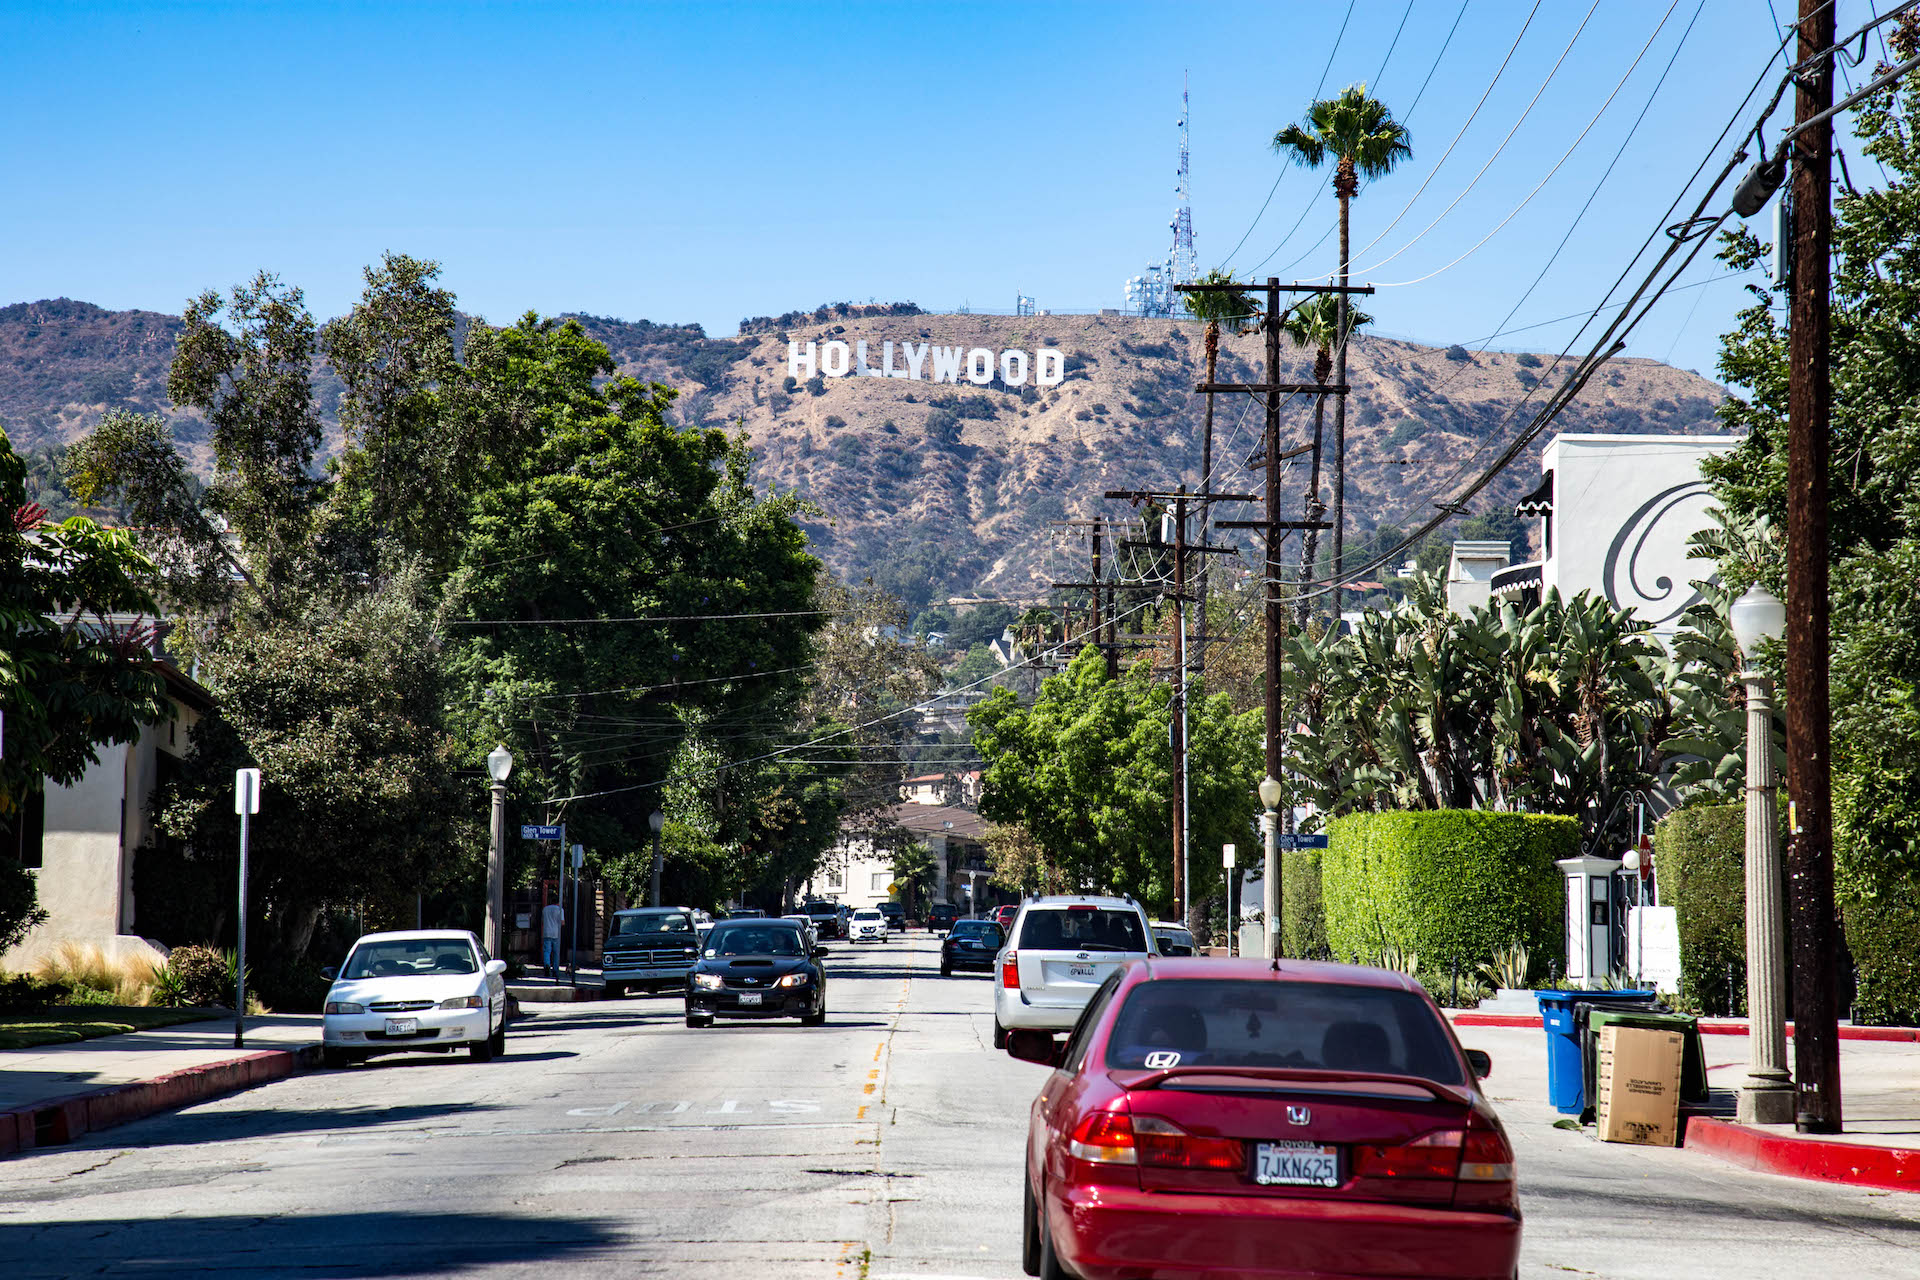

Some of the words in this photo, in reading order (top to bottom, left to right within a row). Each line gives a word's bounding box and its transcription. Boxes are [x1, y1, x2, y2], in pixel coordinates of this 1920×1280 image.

[788, 340, 1064, 386] HOLLYWOOD
[523, 826, 537, 834] Glen
[539, 826, 557, 834] Tower
[1280, 835, 1295, 843] Glen
[1297, 835, 1316, 843] Tower
[1279, 1140, 1316, 1149] TOYOTA
[1260, 1155, 1334, 1179] 7JKN625
[1270, 1176, 1311, 1184] DOWNTOWN
